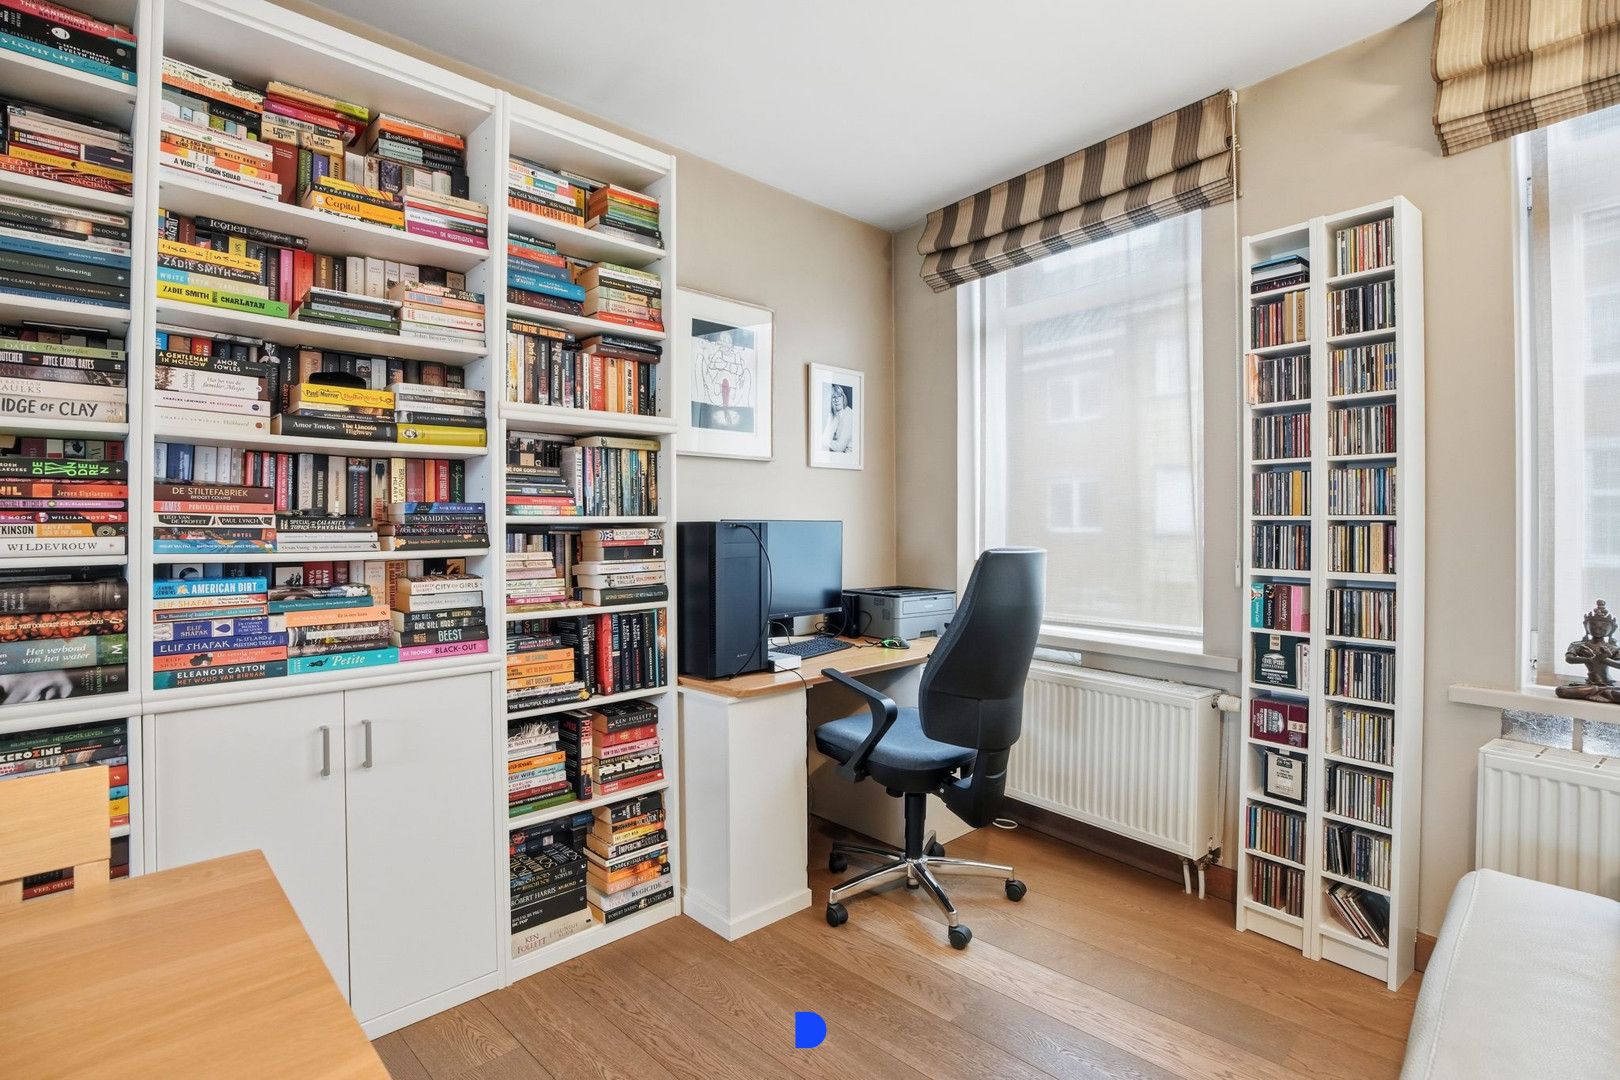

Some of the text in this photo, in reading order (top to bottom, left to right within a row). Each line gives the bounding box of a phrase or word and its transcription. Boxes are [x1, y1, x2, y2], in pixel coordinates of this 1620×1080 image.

[21, 1, 109, 32] THE VANISHING HALF
[11, 39, 50, 57] LOVELY
[58, 45, 111, 66] EVELYN HUGO
[0, 162, 59, 181] ERDRICH
[7, 157, 54, 173] LOUISE
[173, 157, 242, 182] A VISIT GOON SQUAD
[84, 174, 112, 186] NIGHT
[324, 195, 360, 213] Capital
[210, 219, 248, 235] Iconen
[55, 265, 92, 278] Schemering
[163, 256, 232, 278] ZADIE SMITH
[162, 285, 266, 310] ZADIE SMITH CHARLATAN
[42, 355, 59, 367] JOYCE
[59, 356, 78, 369] CAROL
[77, 358, 96, 370] OATES
[165, 351, 209, 363] GENTLEMAN
[172, 358, 207, 368] MOSCOW
[216, 359, 238, 367] AMOR
[213, 363, 241, 373] TOWLES
[592, 356, 602, 390] DOMINION
[320, 389, 340, 400] Murray
[59, 401, 99, 418] CLAY
[293, 421, 336, 431] Amor Towles
[345, 428, 373, 436] Highway
[354, 423, 377, 431] Lincoln
[56, 490, 78, 498] Jeroen
[172, 486, 248, 498] DE STILTEFABRIEK
[160, 501, 181, 512] JAMES
[7, 542, 98, 552] WILDEVROUW
[191, 581, 257, 594] AMERICAN DIRT
[435, 583, 451, 591] CITY
[69, 618, 104, 627] dromedaris
[437, 628, 463, 642] BEEST
[25, 643, 87, 656] Het verbond
[160, 640, 231, 653] ELIF SHAFAK
[434, 643, 477, 655] BLACK-OUT
[22, 652, 91, 665] van het water
[331, 655, 366, 667] Petite
[177, 664, 266, 679] ELEANOR CATTON
[236, 671, 266, 679] BIRNAM
[615, 713, 652, 726] KEN FOLLETT
[510, 886, 557, 907] ROBERT HARRIS
[525, 932, 539, 944] KEN
